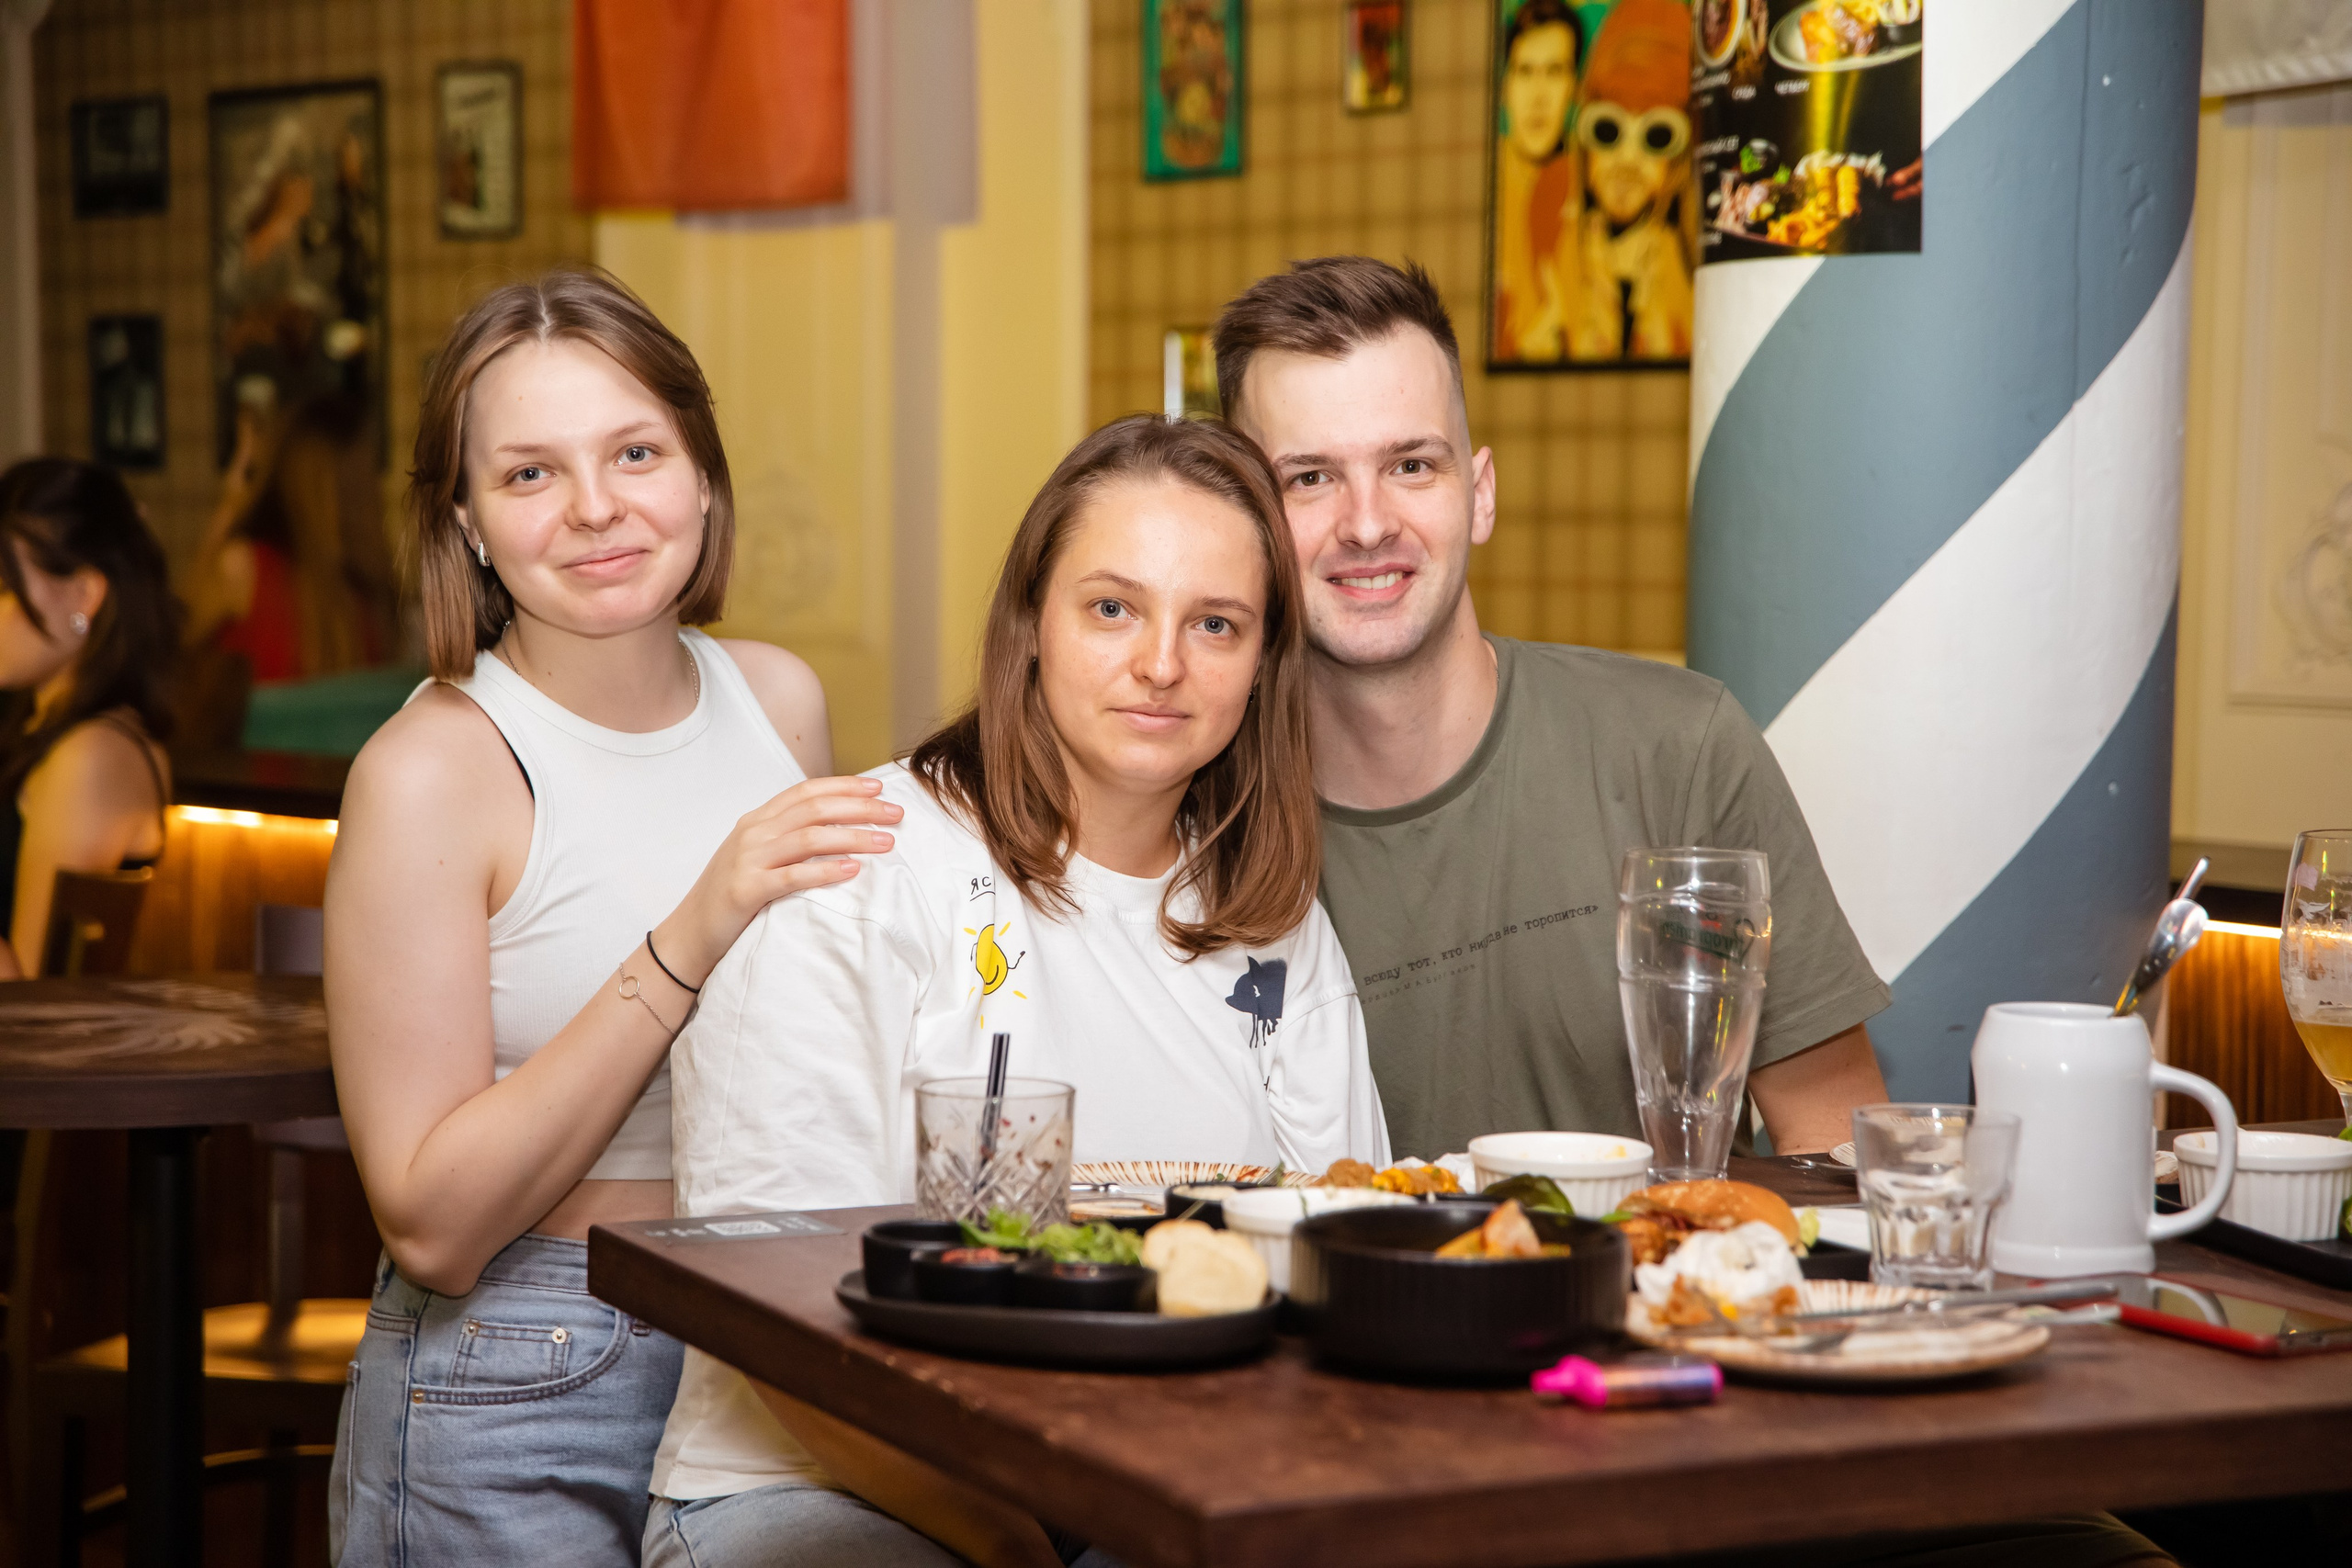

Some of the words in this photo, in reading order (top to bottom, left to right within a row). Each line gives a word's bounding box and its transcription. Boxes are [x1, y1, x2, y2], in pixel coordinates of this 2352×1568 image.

[1363, 966, 1401, 986] всюду
[1408, 957, 1437, 972] тот,
[1441, 947, 1464, 961] кто
[1469, 930, 1502, 953] ниуда
[1502, 924, 1519, 936] не
[1524, 904, 1600, 931] торопится»
